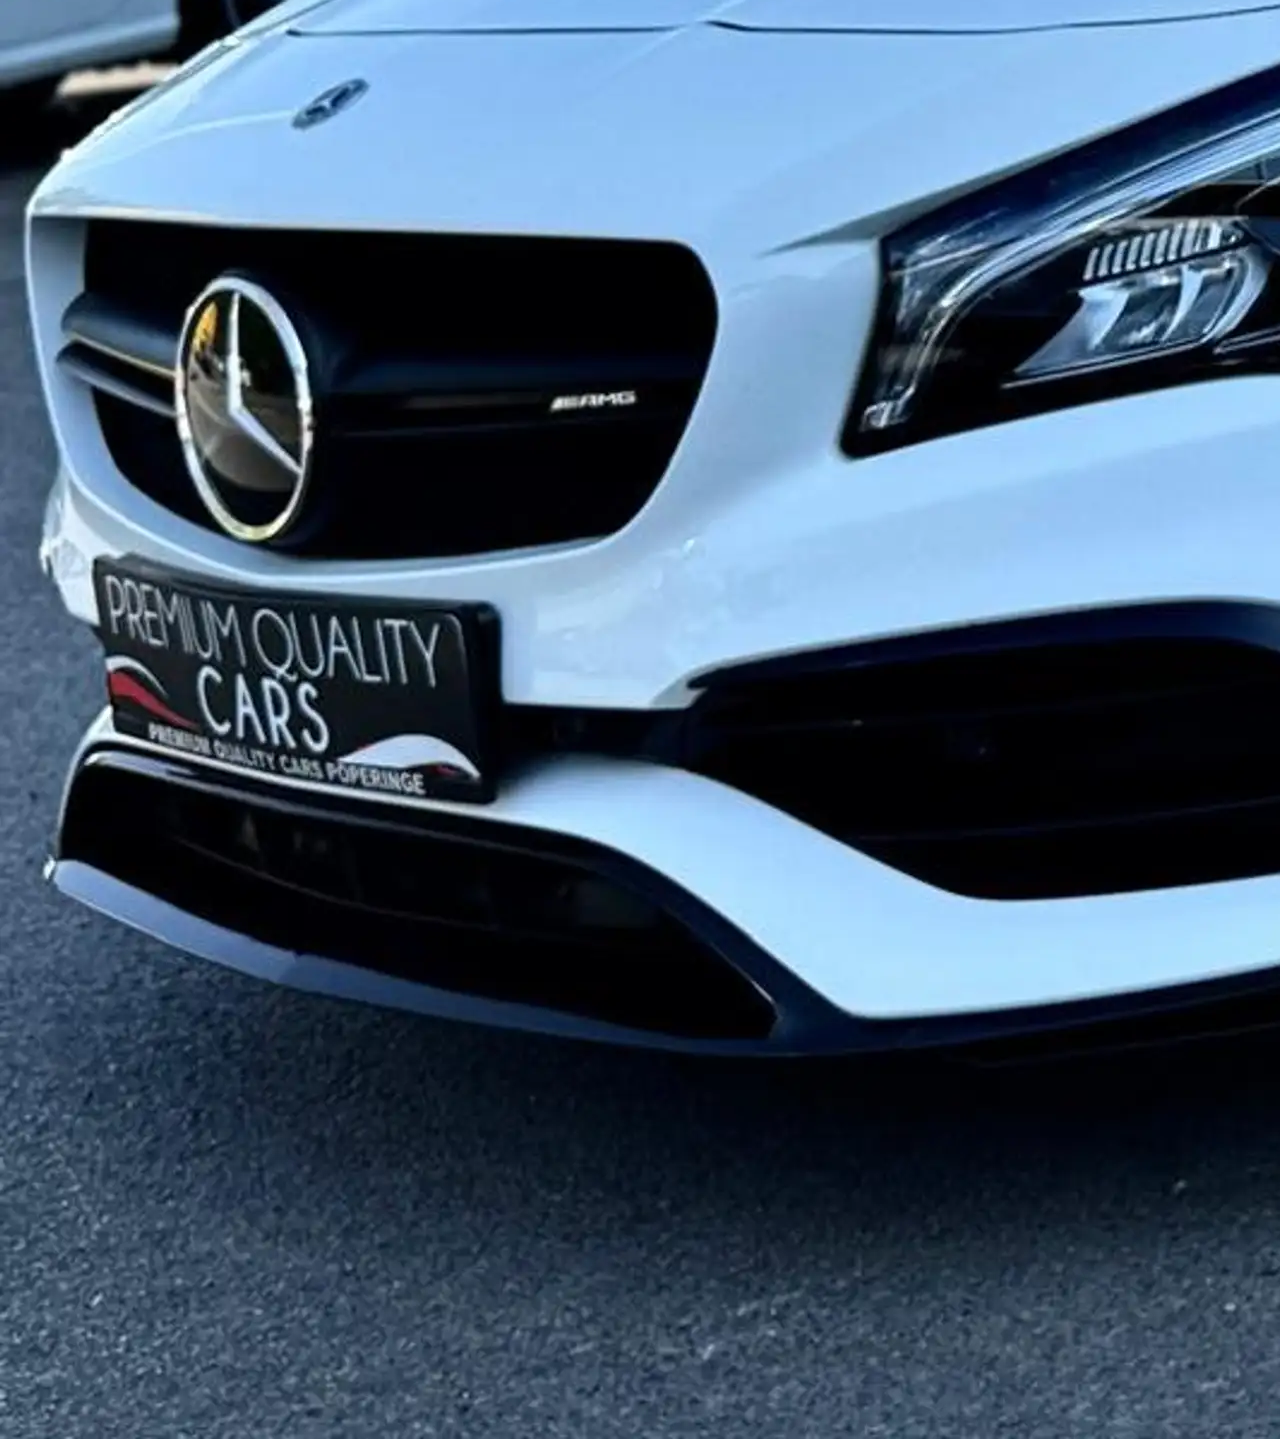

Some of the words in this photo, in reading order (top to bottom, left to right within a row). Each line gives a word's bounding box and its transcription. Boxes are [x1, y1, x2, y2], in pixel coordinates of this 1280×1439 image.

[104, 574, 247, 667] PREMIUM
[252, 607, 441, 689] QUALITY
[197, 666, 330, 753] CARS
[148, 722, 211, 757] PREMIUM
[213, 740, 277, 771] QUALITY
[277, 753, 323, 779] CARS
[327, 761, 427, 795] POPERINGE
